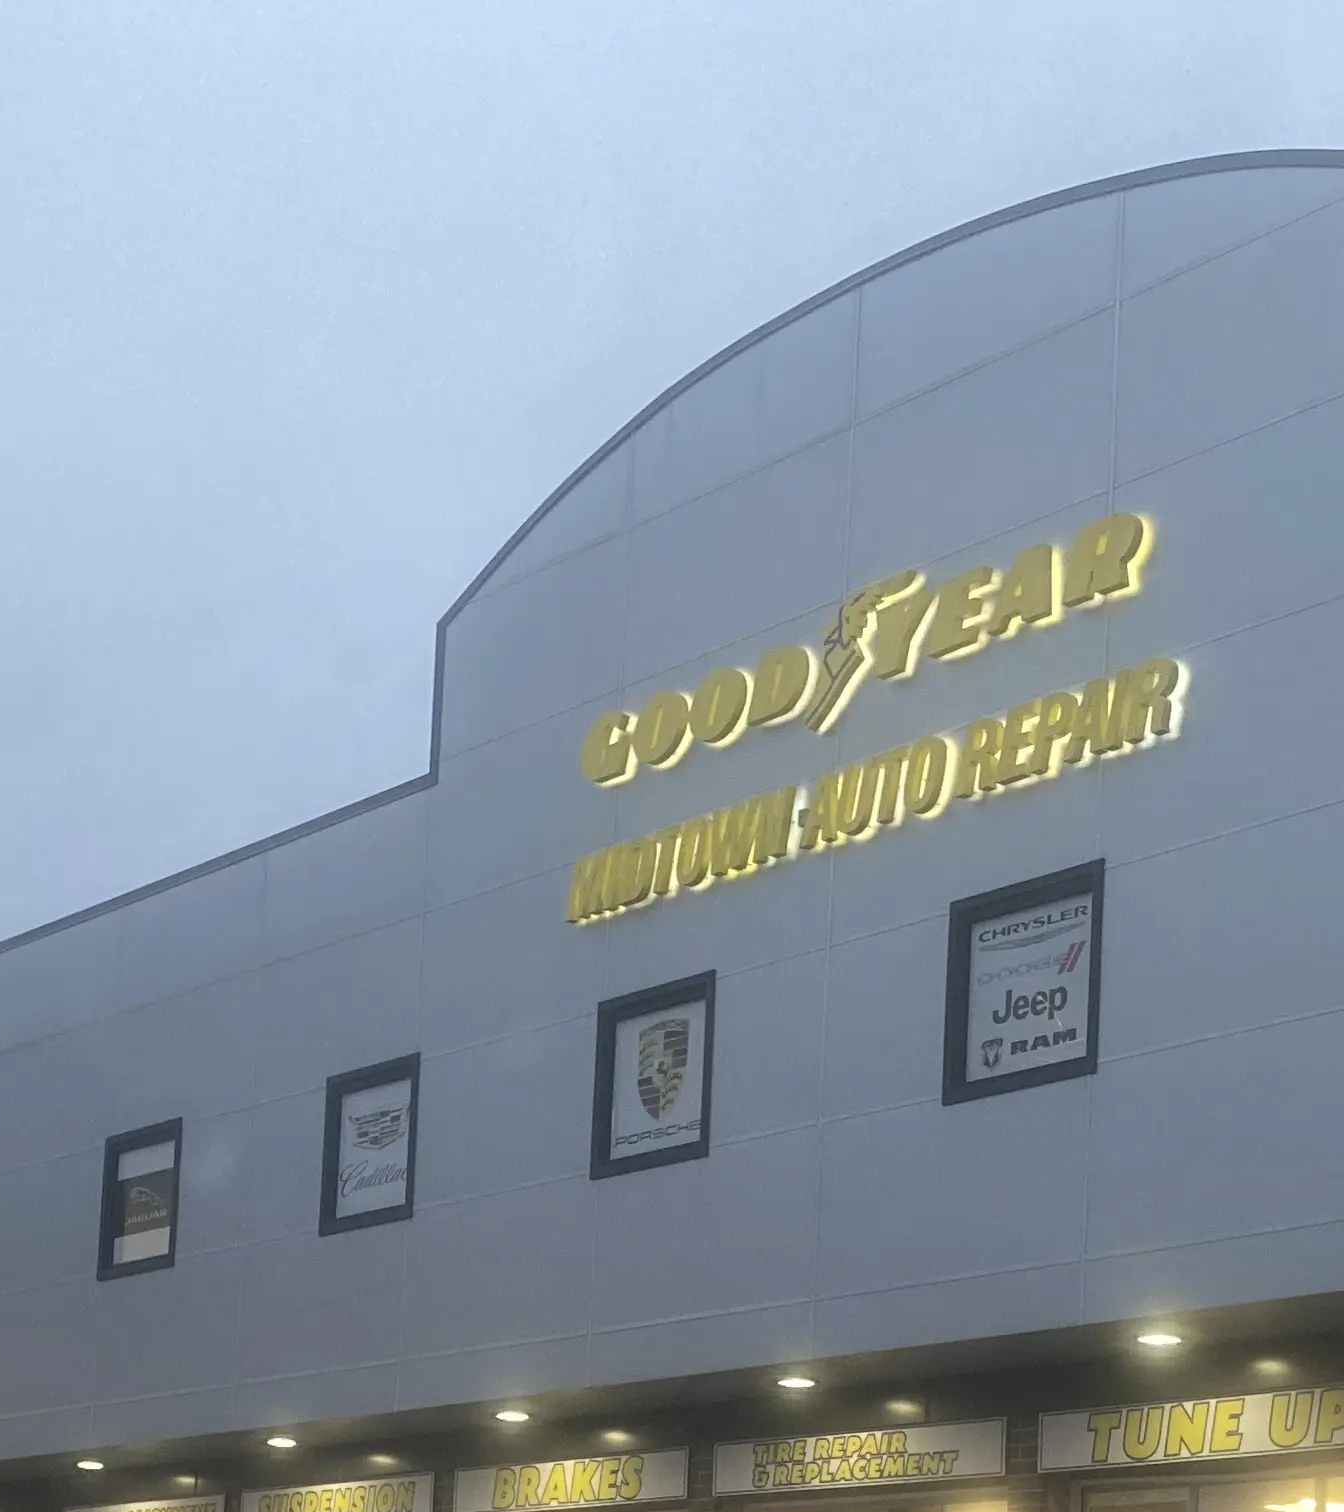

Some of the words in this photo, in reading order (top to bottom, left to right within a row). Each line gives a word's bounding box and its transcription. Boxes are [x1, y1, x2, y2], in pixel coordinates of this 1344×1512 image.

[581, 511, 1150, 786] GOODYEAR
[566, 786, 797, 924] MIDTOWN
[800, 737, 953, 851] AUTO
[955, 658, 1182, 800] REPAIR
[978, 904, 1088, 943] CHRYSLER
[992, 986, 1067, 1025] Jeep
[1010, 1028, 1077, 1056] RAM
[752, 1439, 808, 1466] TIRE
[814, 1432, 908, 1461] REPAIR
[1087, 1397, 1246, 1463] TUNE
[492, 1456, 644, 1510] BRAKES
[773, 1450, 959, 1488] REPLACEMENT
